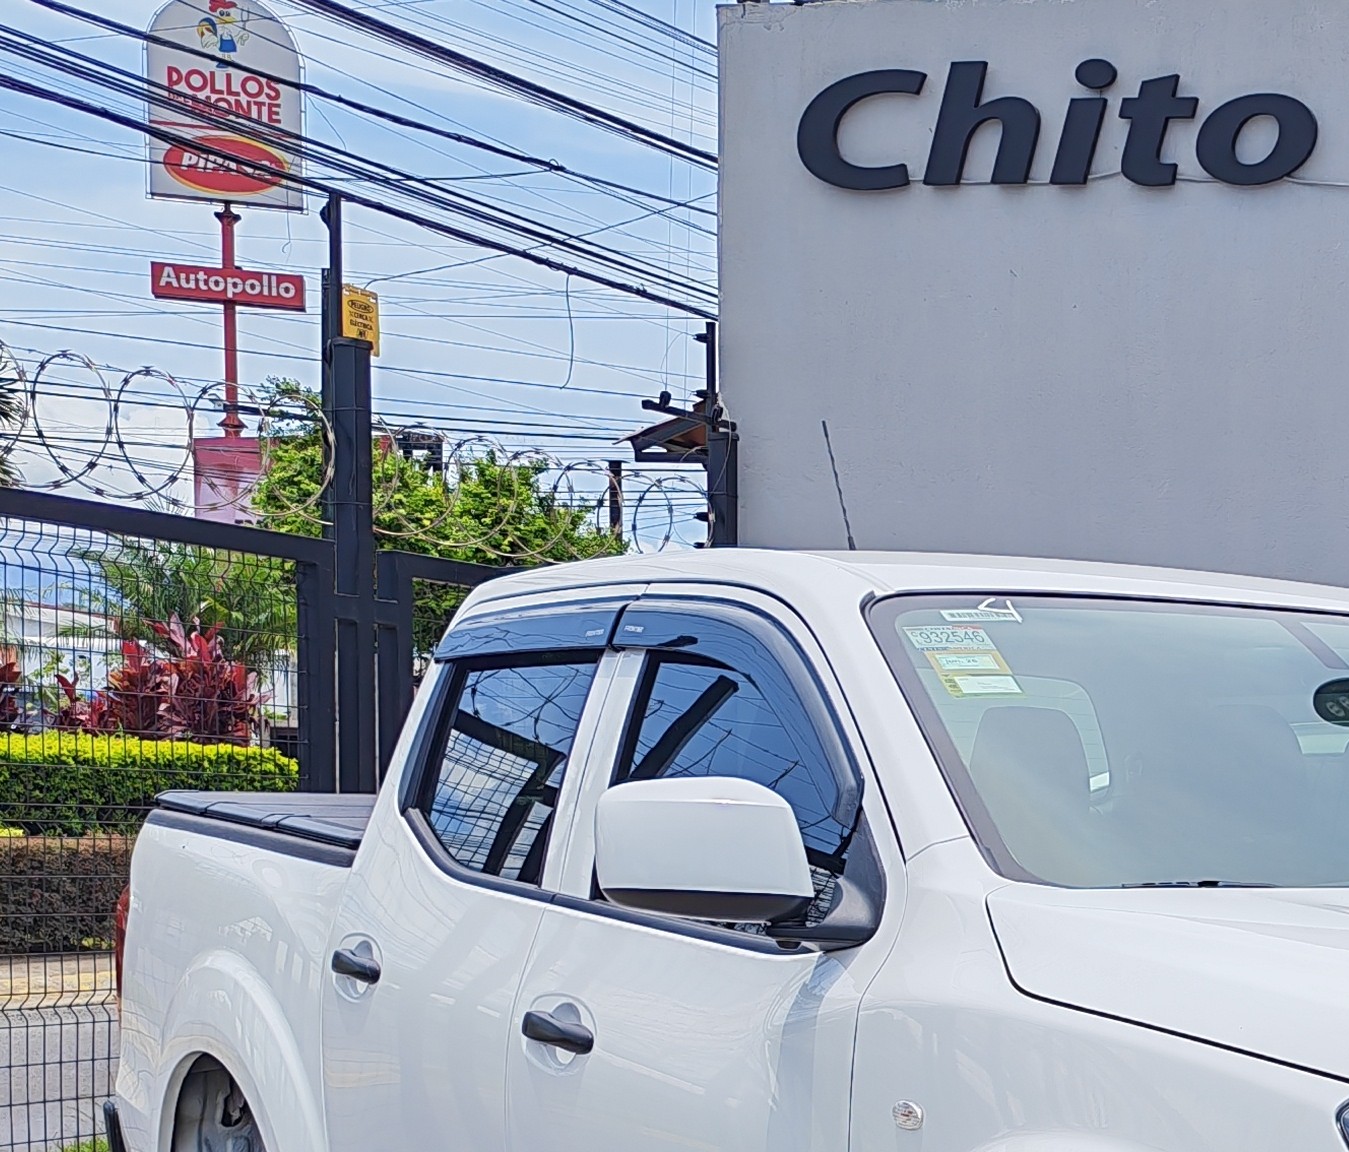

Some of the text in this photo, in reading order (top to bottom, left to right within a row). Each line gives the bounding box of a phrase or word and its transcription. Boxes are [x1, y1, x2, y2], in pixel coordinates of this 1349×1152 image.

[166, 65, 282, 102] POLLOS
[796, 59, 1318, 192] Chito
[158, 266, 296, 299] Autopollo
[919, 630, 985, 644] 932546
